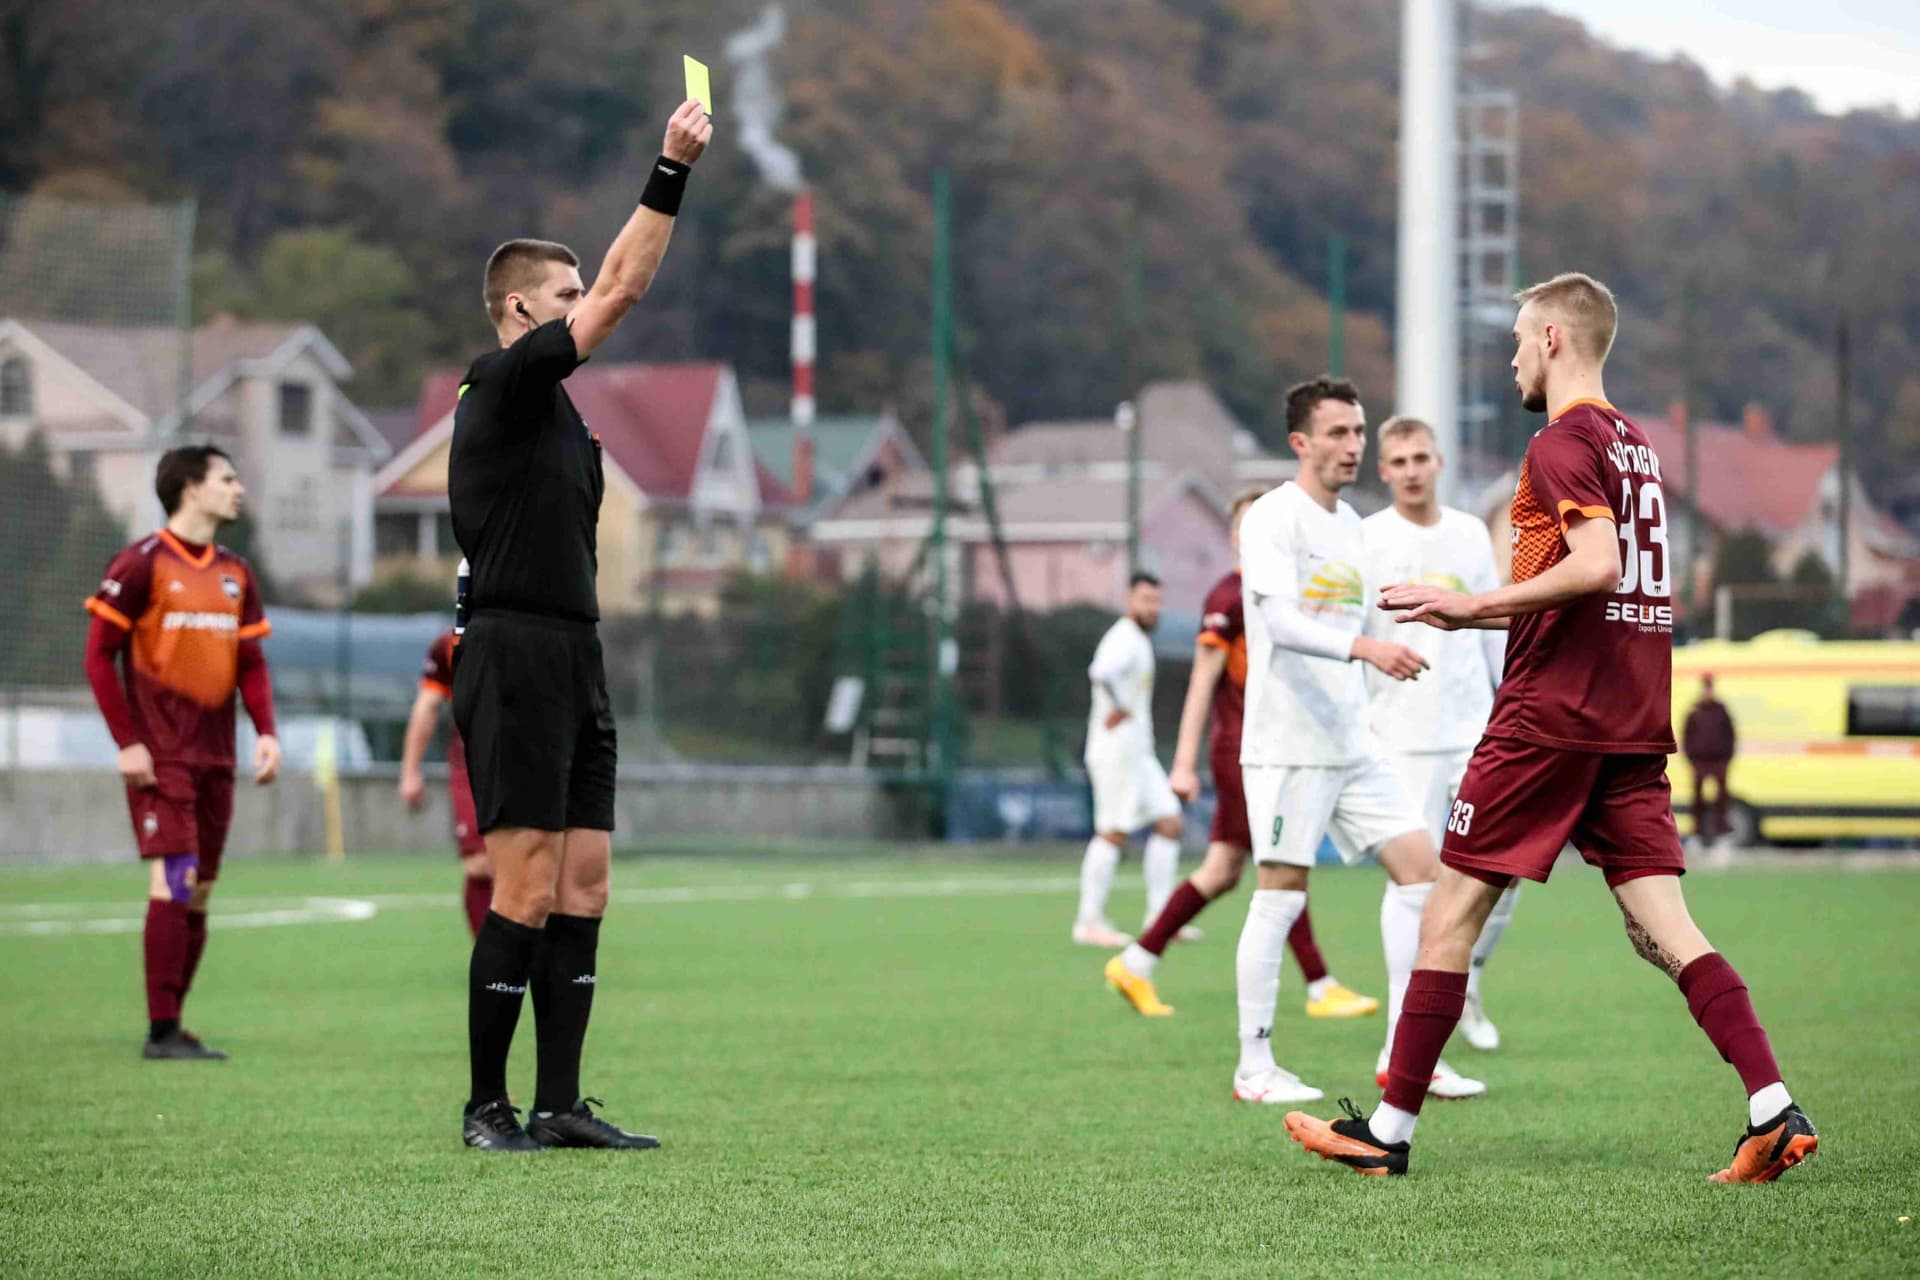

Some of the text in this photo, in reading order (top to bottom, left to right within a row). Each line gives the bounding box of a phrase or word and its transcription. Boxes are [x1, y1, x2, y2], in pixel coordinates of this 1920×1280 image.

[1616, 478, 1671, 597] 33
[1605, 601, 1672, 624] SEUS
[1271, 815, 1283, 847] 9
[1448, 799, 1474, 836] 33
